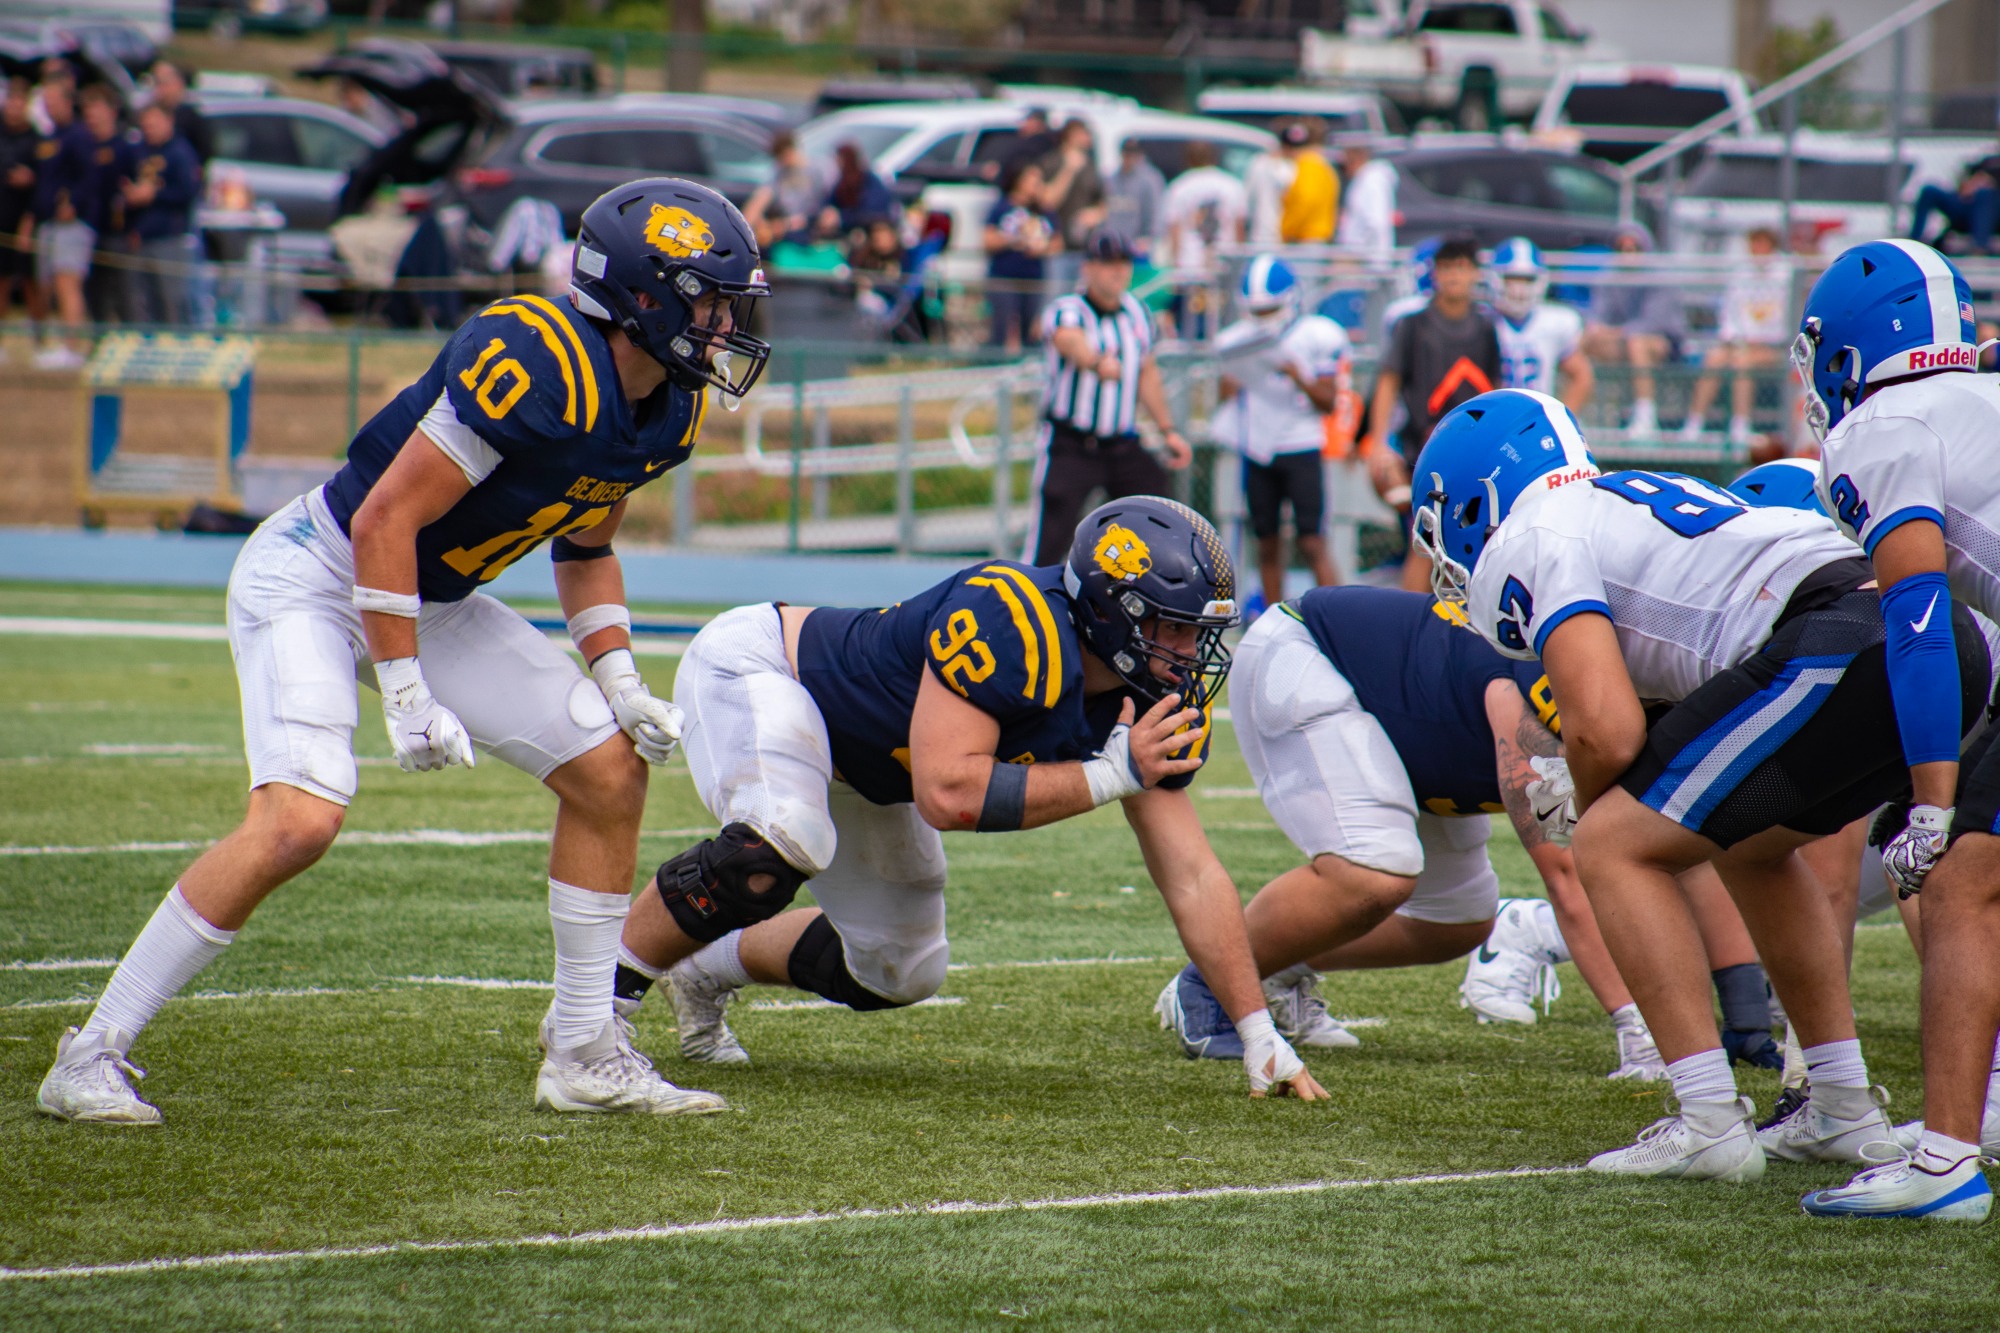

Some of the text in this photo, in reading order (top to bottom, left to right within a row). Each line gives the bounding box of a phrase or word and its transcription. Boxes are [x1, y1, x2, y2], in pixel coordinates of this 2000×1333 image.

[1892, 319, 1902, 332] 2
[1908, 347, 1977, 371] Riddell
[459, 337, 531, 419] 10
[1541, 437, 1555, 449] 87
[565, 475, 633, 503] BEAVERS
[1546, 468, 1600, 490] Ridd
[1830, 473, 1872, 537] 2
[929, 608, 997, 697] 92
